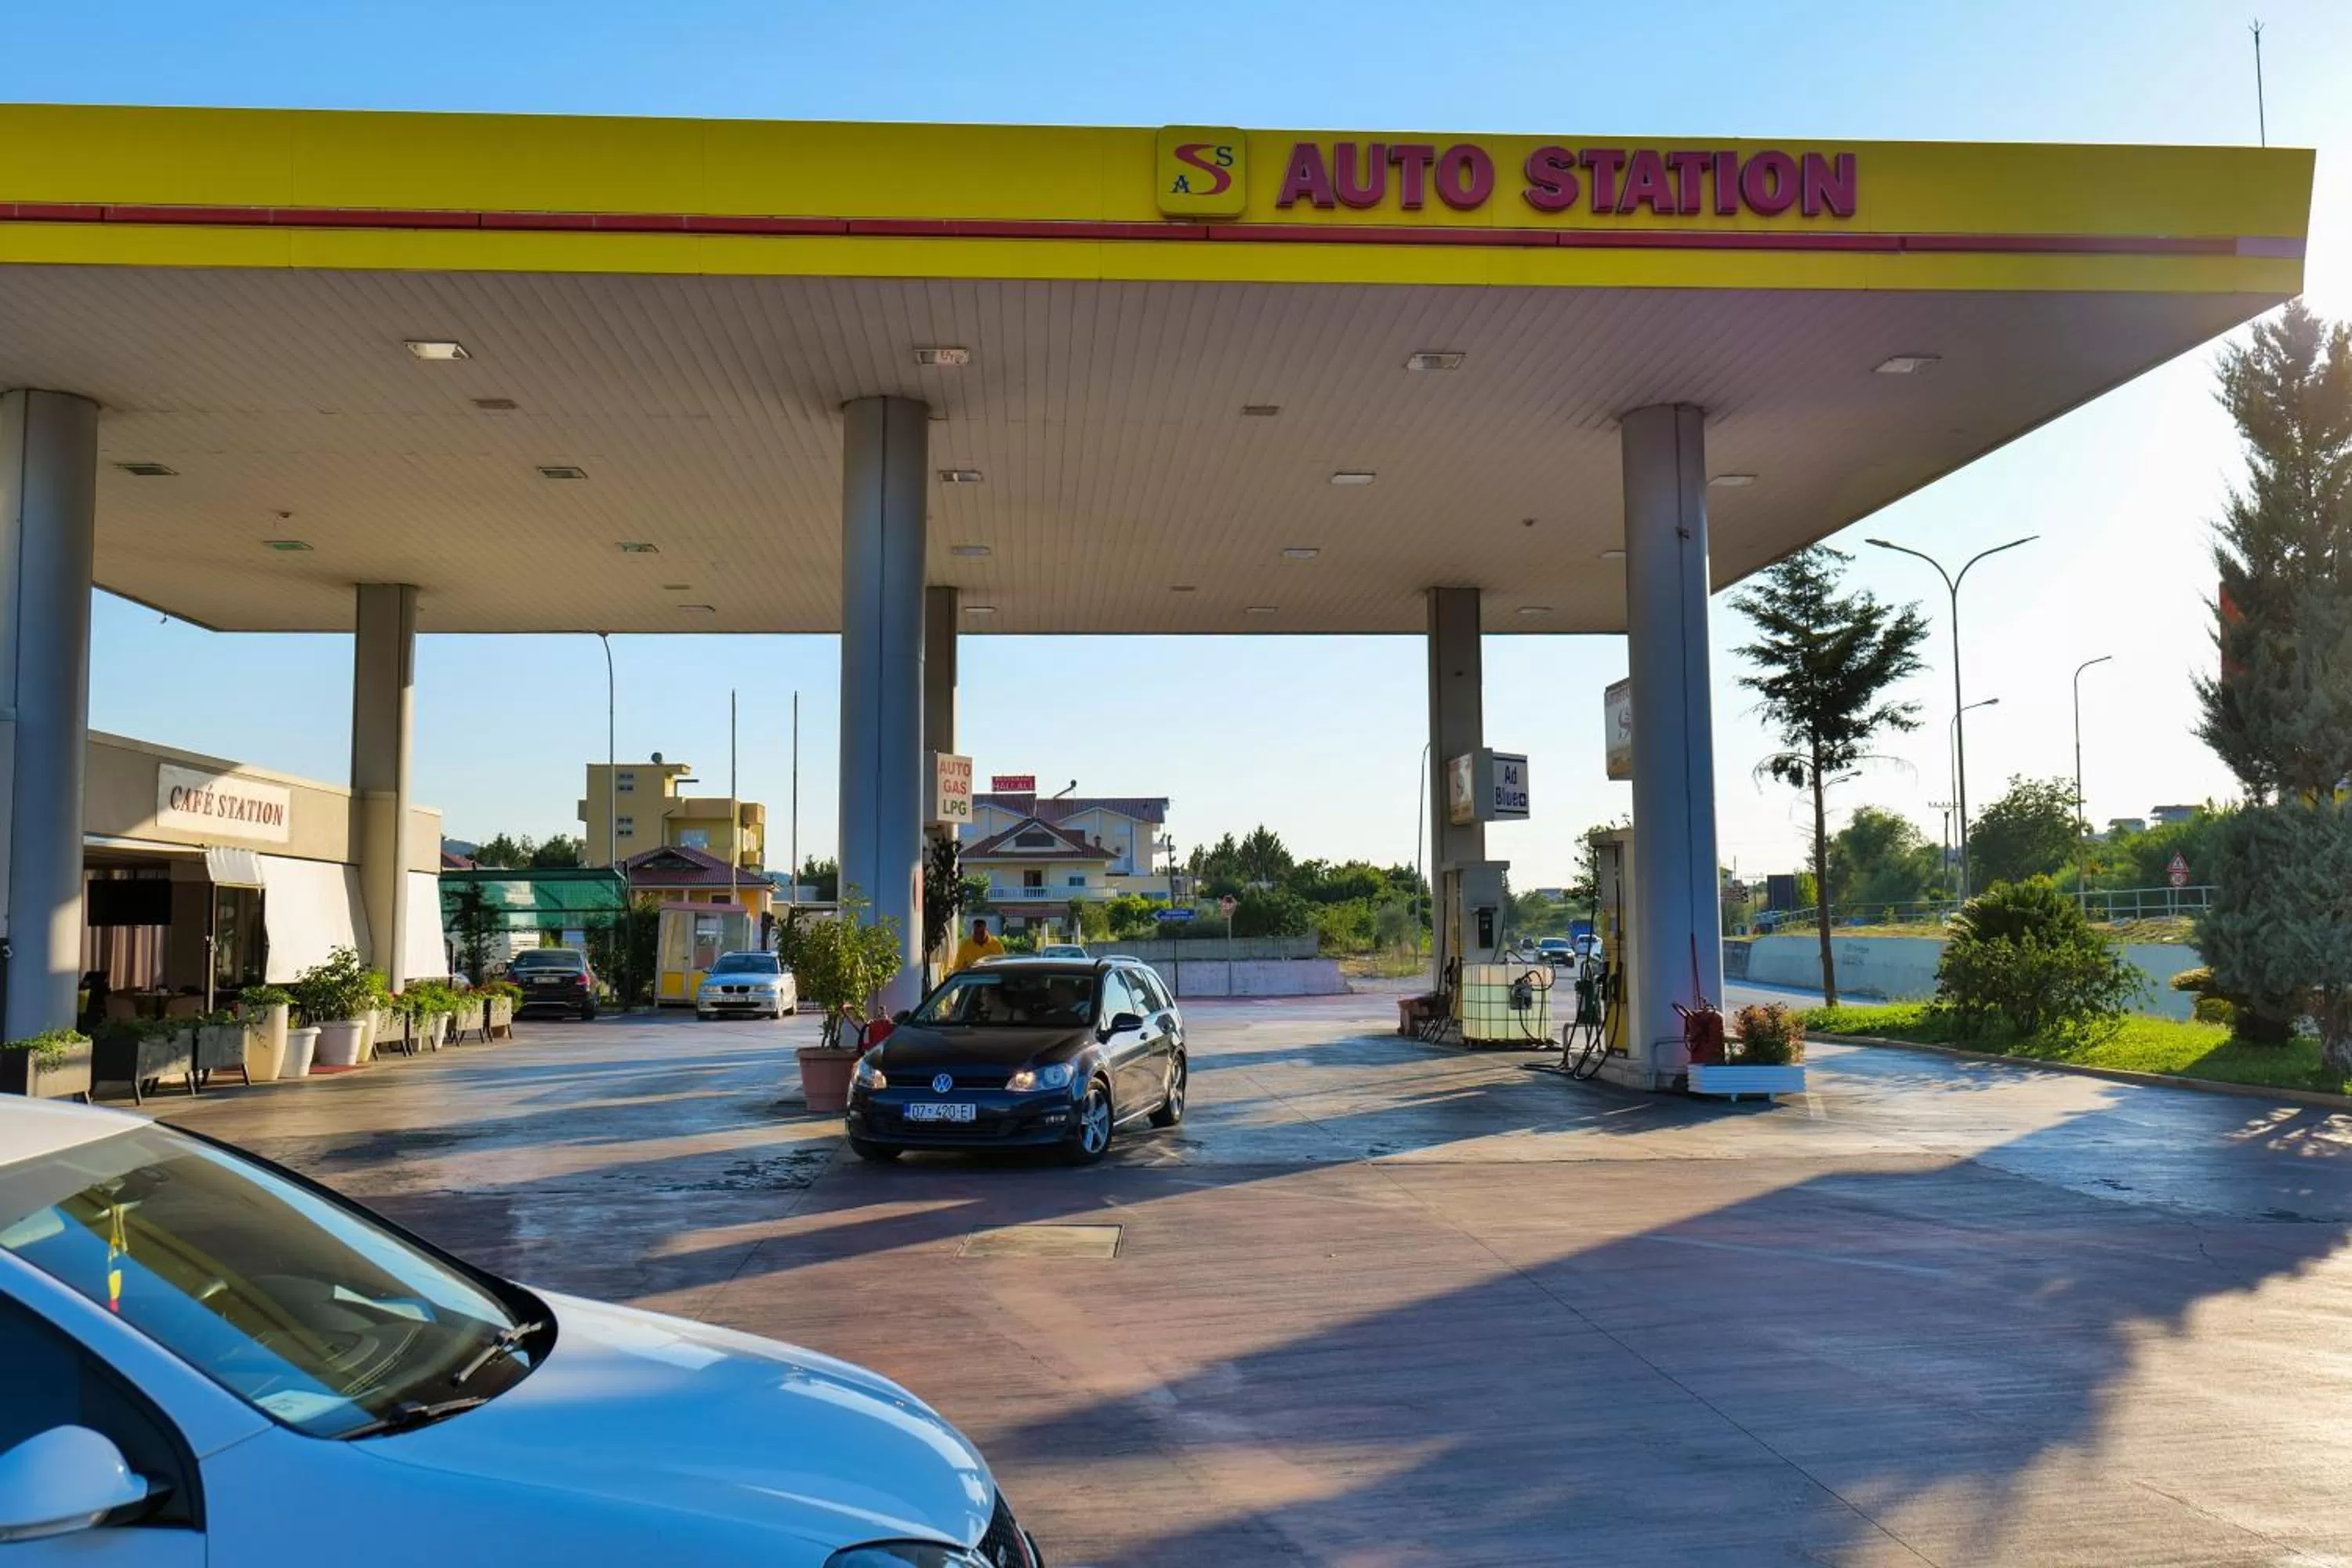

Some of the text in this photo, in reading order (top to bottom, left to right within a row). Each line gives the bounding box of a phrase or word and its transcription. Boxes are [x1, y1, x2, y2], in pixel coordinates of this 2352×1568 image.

[1276, 143, 1857, 217] AUTO STATION
[939, 760, 971, 776] AUTO
[1504, 765, 1517, 785] Ad
[943, 779, 967, 795] GAS
[170, 784, 284, 826] CAFÉ STATION
[943, 799, 967, 815] LPG
